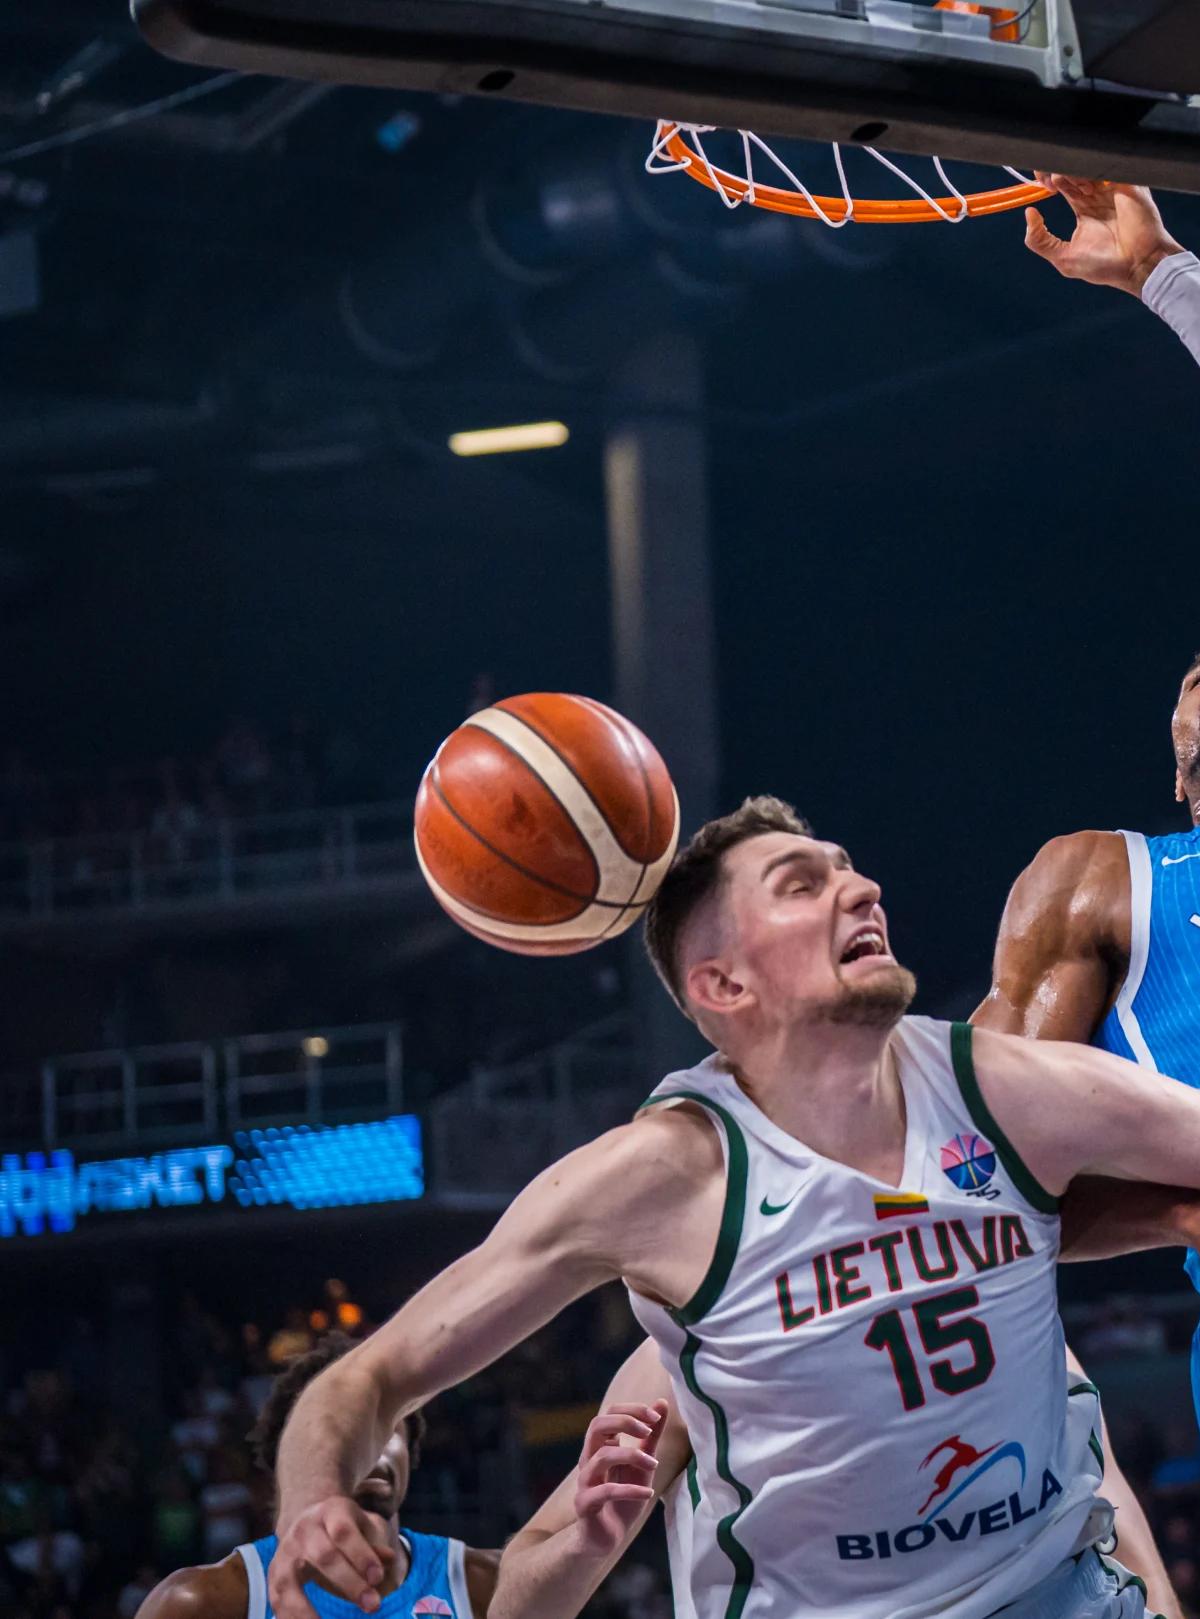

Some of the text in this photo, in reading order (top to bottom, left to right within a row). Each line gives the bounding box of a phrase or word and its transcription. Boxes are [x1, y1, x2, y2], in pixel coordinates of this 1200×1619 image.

[774, 1214, 1036, 1333] LIETUVA
[863, 1284, 997, 1412] 15
[835, 1467, 1063, 1561] BIOVELA
